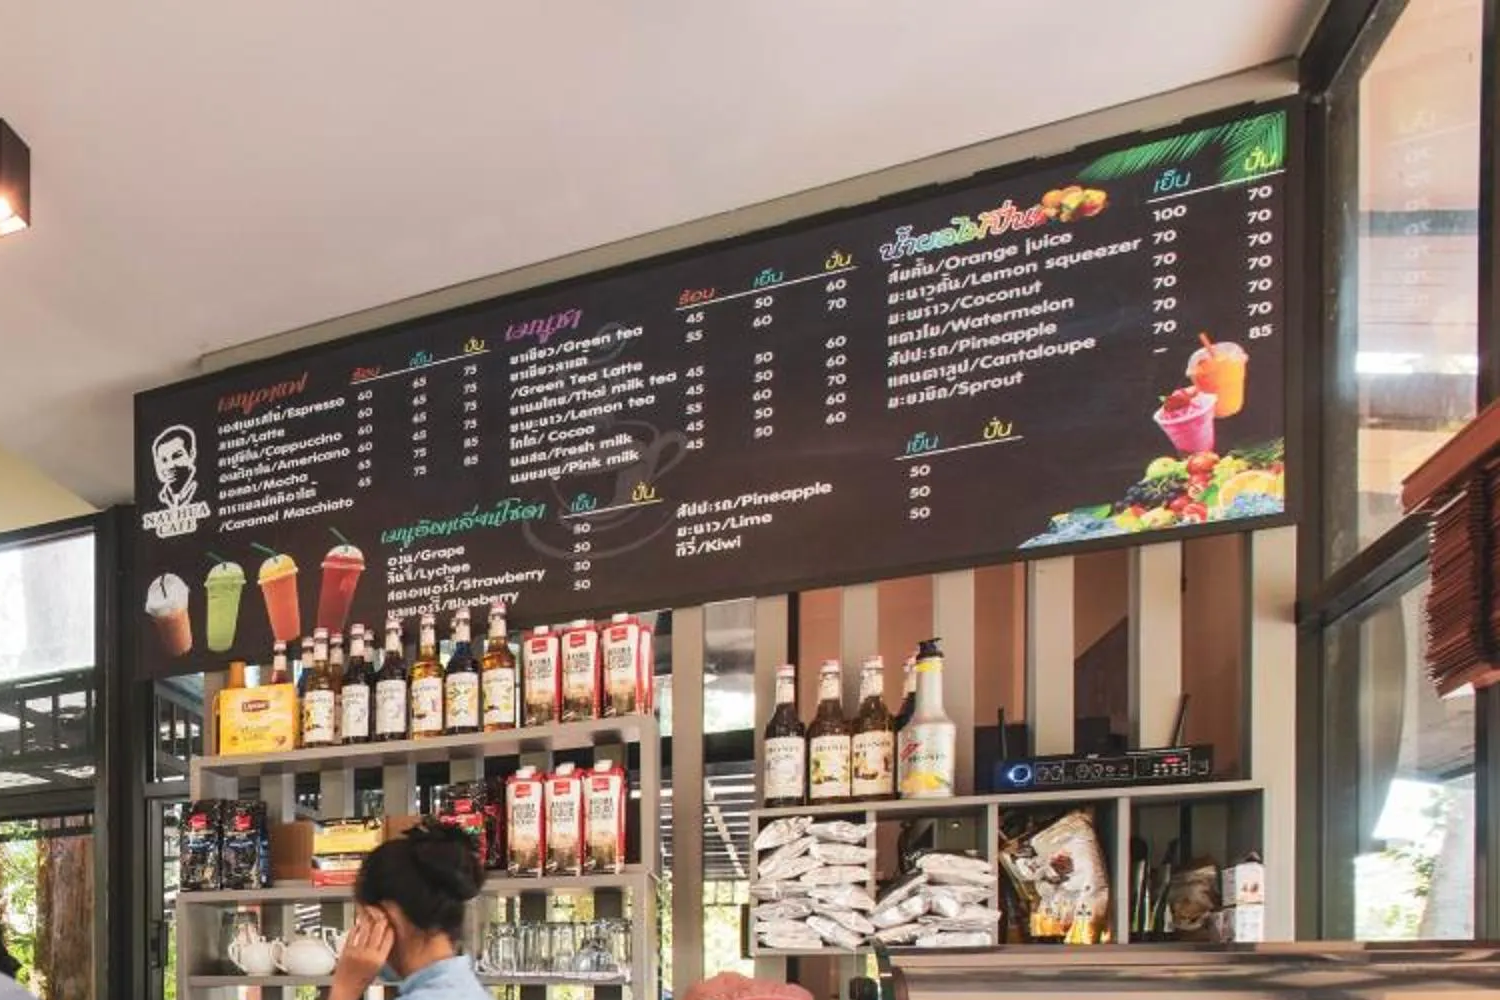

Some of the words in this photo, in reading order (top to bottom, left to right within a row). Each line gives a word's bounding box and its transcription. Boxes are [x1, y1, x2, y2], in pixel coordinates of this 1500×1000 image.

[1026, 232, 1072, 255] juice
[1153, 205, 1188, 222] 100
[1248, 185, 1273, 200] 70
[1045, 238, 1142, 269] squeezer
[1153, 230, 1177, 244] 70
[1248, 209, 1273, 224] 70
[1153, 252, 1177, 267] 70
[1248, 232, 1273, 247] 70
[617, 326, 643, 341] tea
[686, 312, 704, 324] 45
[753, 296, 773, 309] 50
[825, 279, 847, 292] 60
[888, 296, 1075, 347] แตงโม/Watermelon
[1153, 275, 1177, 290] 70
[1248, 255, 1273, 270] 70
[1153, 298, 1177, 312] 70
[1248, 278, 1273, 293] 70
[686, 330, 704, 342] 55
[753, 315, 773, 327] 60
[825, 298, 847, 311] 70
[1153, 320, 1177, 334] 70
[1248, 301, 1273, 316] 70
[1249, 324, 1273, 339] 85
[510, 381, 565, 401] /Green
[570, 372, 598, 387] Tea
[603, 362, 643, 379] Latte
[611, 378, 644, 395] milk
[650, 372, 677, 387] tea
[686, 366, 704, 378] 45
[753, 351, 773, 364] 50
[825, 335, 847, 349] 60
[628, 395, 656, 410] tea
[686, 384, 704, 396] 45
[753, 370, 773, 383] 50
[825, 354, 847, 368] 60
[357, 390, 373, 401] 60
[357, 407, 373, 419] 60
[548, 425, 595, 441] Cocoa
[686, 402, 704, 414] 55
[753, 389, 773, 401] 60
[825, 373, 847, 387] 70
[357, 424, 373, 435] 60
[599, 432, 633, 450] milk
[686, 420, 704, 432] 45
[753, 407, 773, 419] 50
[825, 392, 847, 406] 60
[606, 450, 640, 466] milk
[686, 439, 704, 450] 45
[753, 425, 773, 438] 50
[825, 411, 847, 424] 60
[357, 441, 373, 452] 60
[357, 459, 373, 470] 65
[909, 464, 931, 478] 50
[357, 477, 373, 488] 65
[219, 513, 279, 533] /Caramel
[284, 498, 354, 520] Macchiato
[676, 511, 772, 538] มะนาว/Lime
[909, 484, 931, 499] 50
[909, 506, 931, 521] 50
[573, 542, 591, 554] 50
[573, 580, 591, 591] 50
